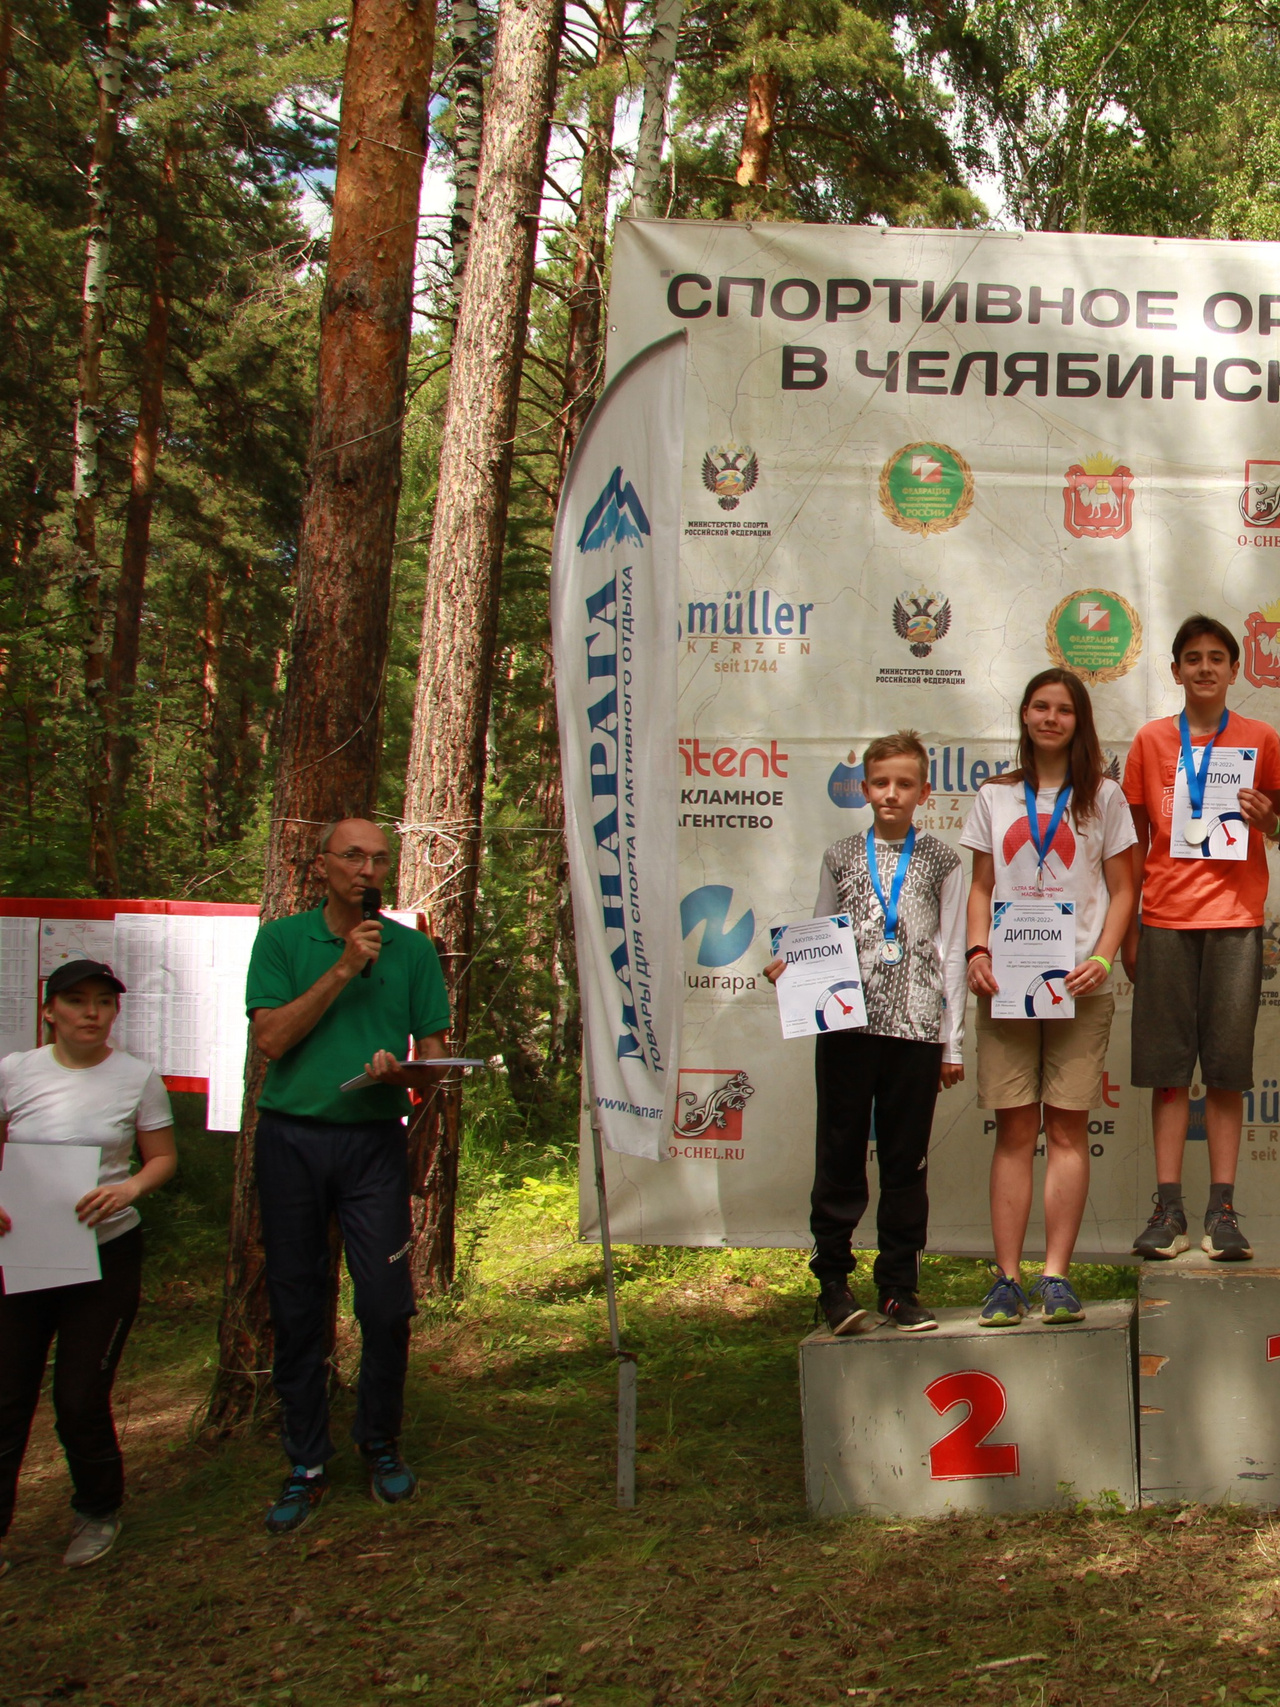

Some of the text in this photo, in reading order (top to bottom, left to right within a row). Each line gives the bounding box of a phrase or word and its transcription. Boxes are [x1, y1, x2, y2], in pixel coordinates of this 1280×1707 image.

[666, 272, 1179, 331] СПОРТИВНОЕ
[780, 345, 829, 391] В
[902, 487, 951, 496] ФЕДЕРАЦИЯ
[906, 508, 945, 517] РОССИИ
[688, 521, 769, 529] МИНИСТЕРСТВО СПОРТА
[684, 528, 772, 538] РОССИЙСКОЙ ФЕДЕРАЦИИ
[687, 590, 814, 636] müller
[1069, 635, 1119, 644] ФЕДЕРАЦИЯ
[687, 641, 811, 655] KERZEN
[714, 659, 778, 674] seit 1744
[1073, 657, 1114, 666] РОССИИ
[879, 667, 963, 677] МИНИСТЕРСТВО СПОРТА
[875, 674, 966, 685] РОССИЙСКОЙ ФЕДЕРАЦИИ
[680, 789, 783, 806] КЛАМНОЕ
[585, 570, 648, 1070] МАНАРАГА
[620, 565, 665, 1074] ТОВАРЫ ДЛЯ СПОРТА И АКТИВНОГО ОТДЫХА
[938, 816, 963, 830] 174
[1004, 929, 1062, 943] ДИПЛОМ
[786, 943, 843, 965] ДИПЛОМ
[668, 1146, 745, 1160] O-CHEL.RU
[1251, 1147, 1277, 1162] seit
[922, 1370, 1020, 1480] 2
